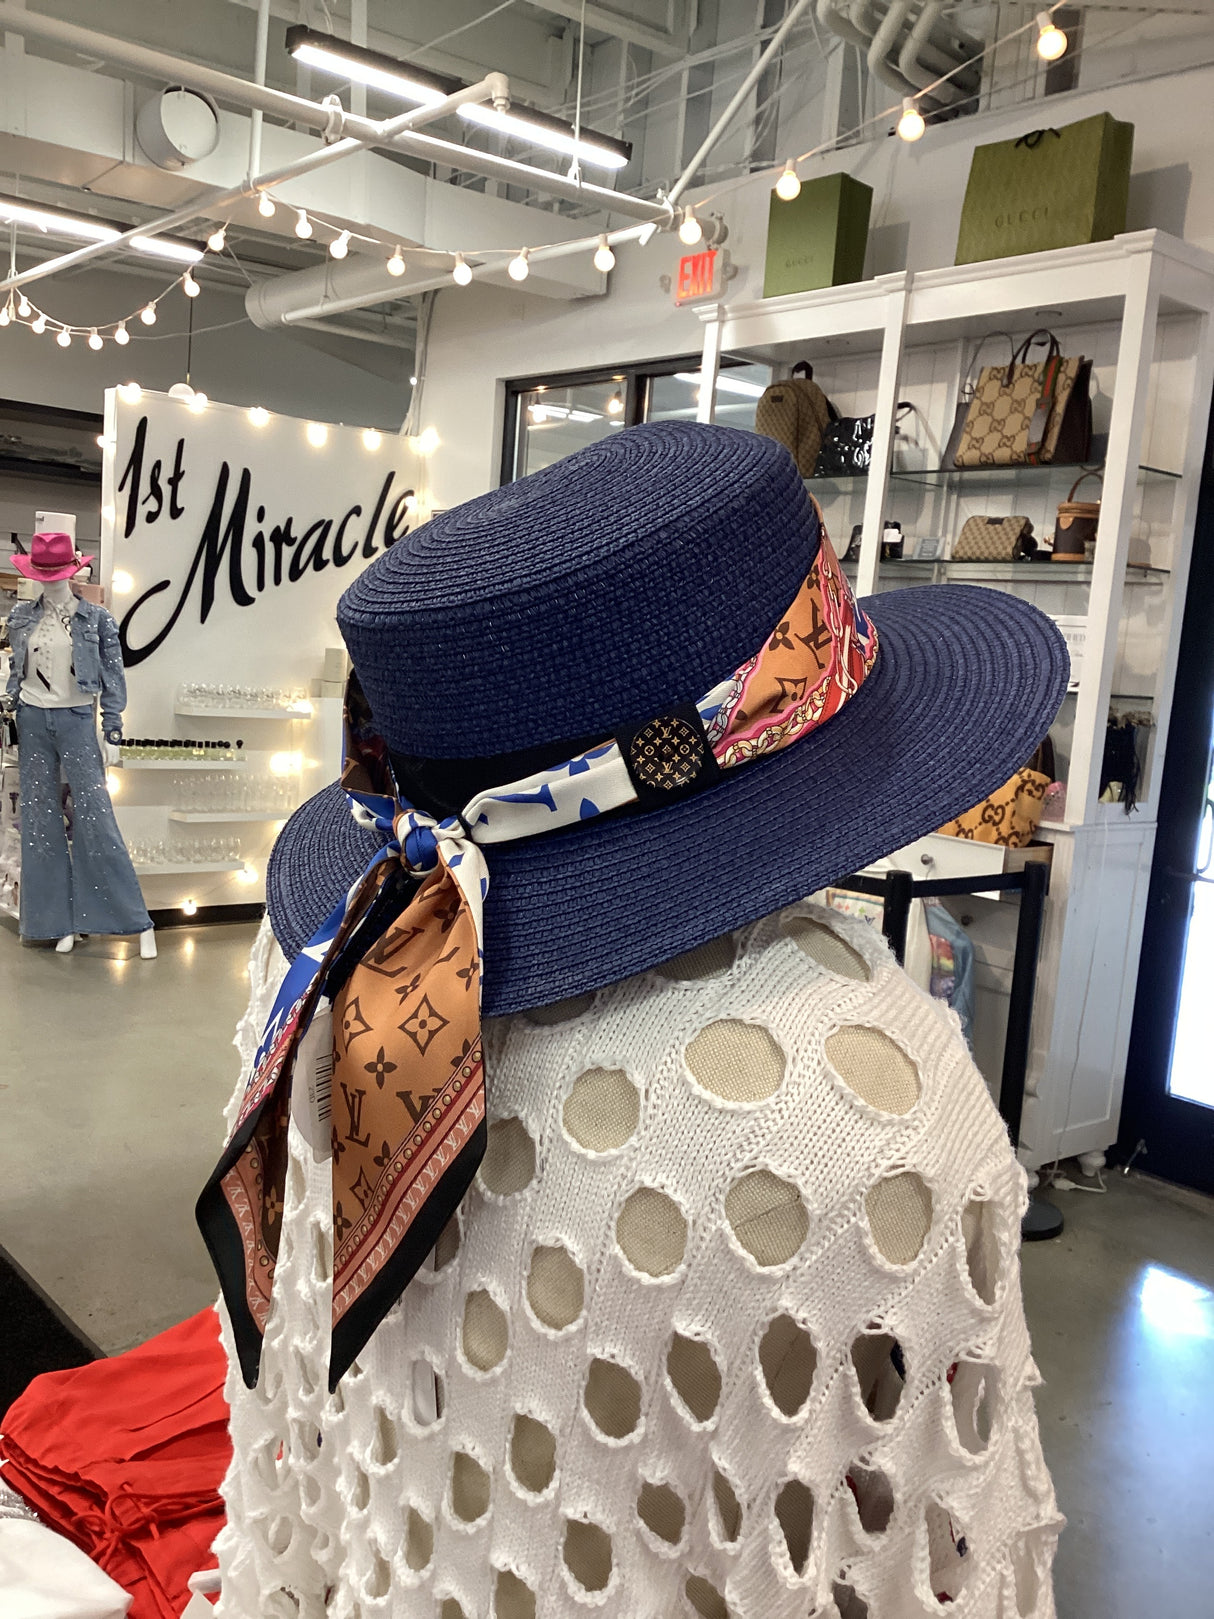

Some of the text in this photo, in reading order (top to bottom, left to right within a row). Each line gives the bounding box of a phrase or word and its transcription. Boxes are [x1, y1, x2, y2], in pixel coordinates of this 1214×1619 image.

[677, 251, 717, 299] EXIT
[118, 416, 185, 539] 1st
[118, 461, 414, 668] Miracle
